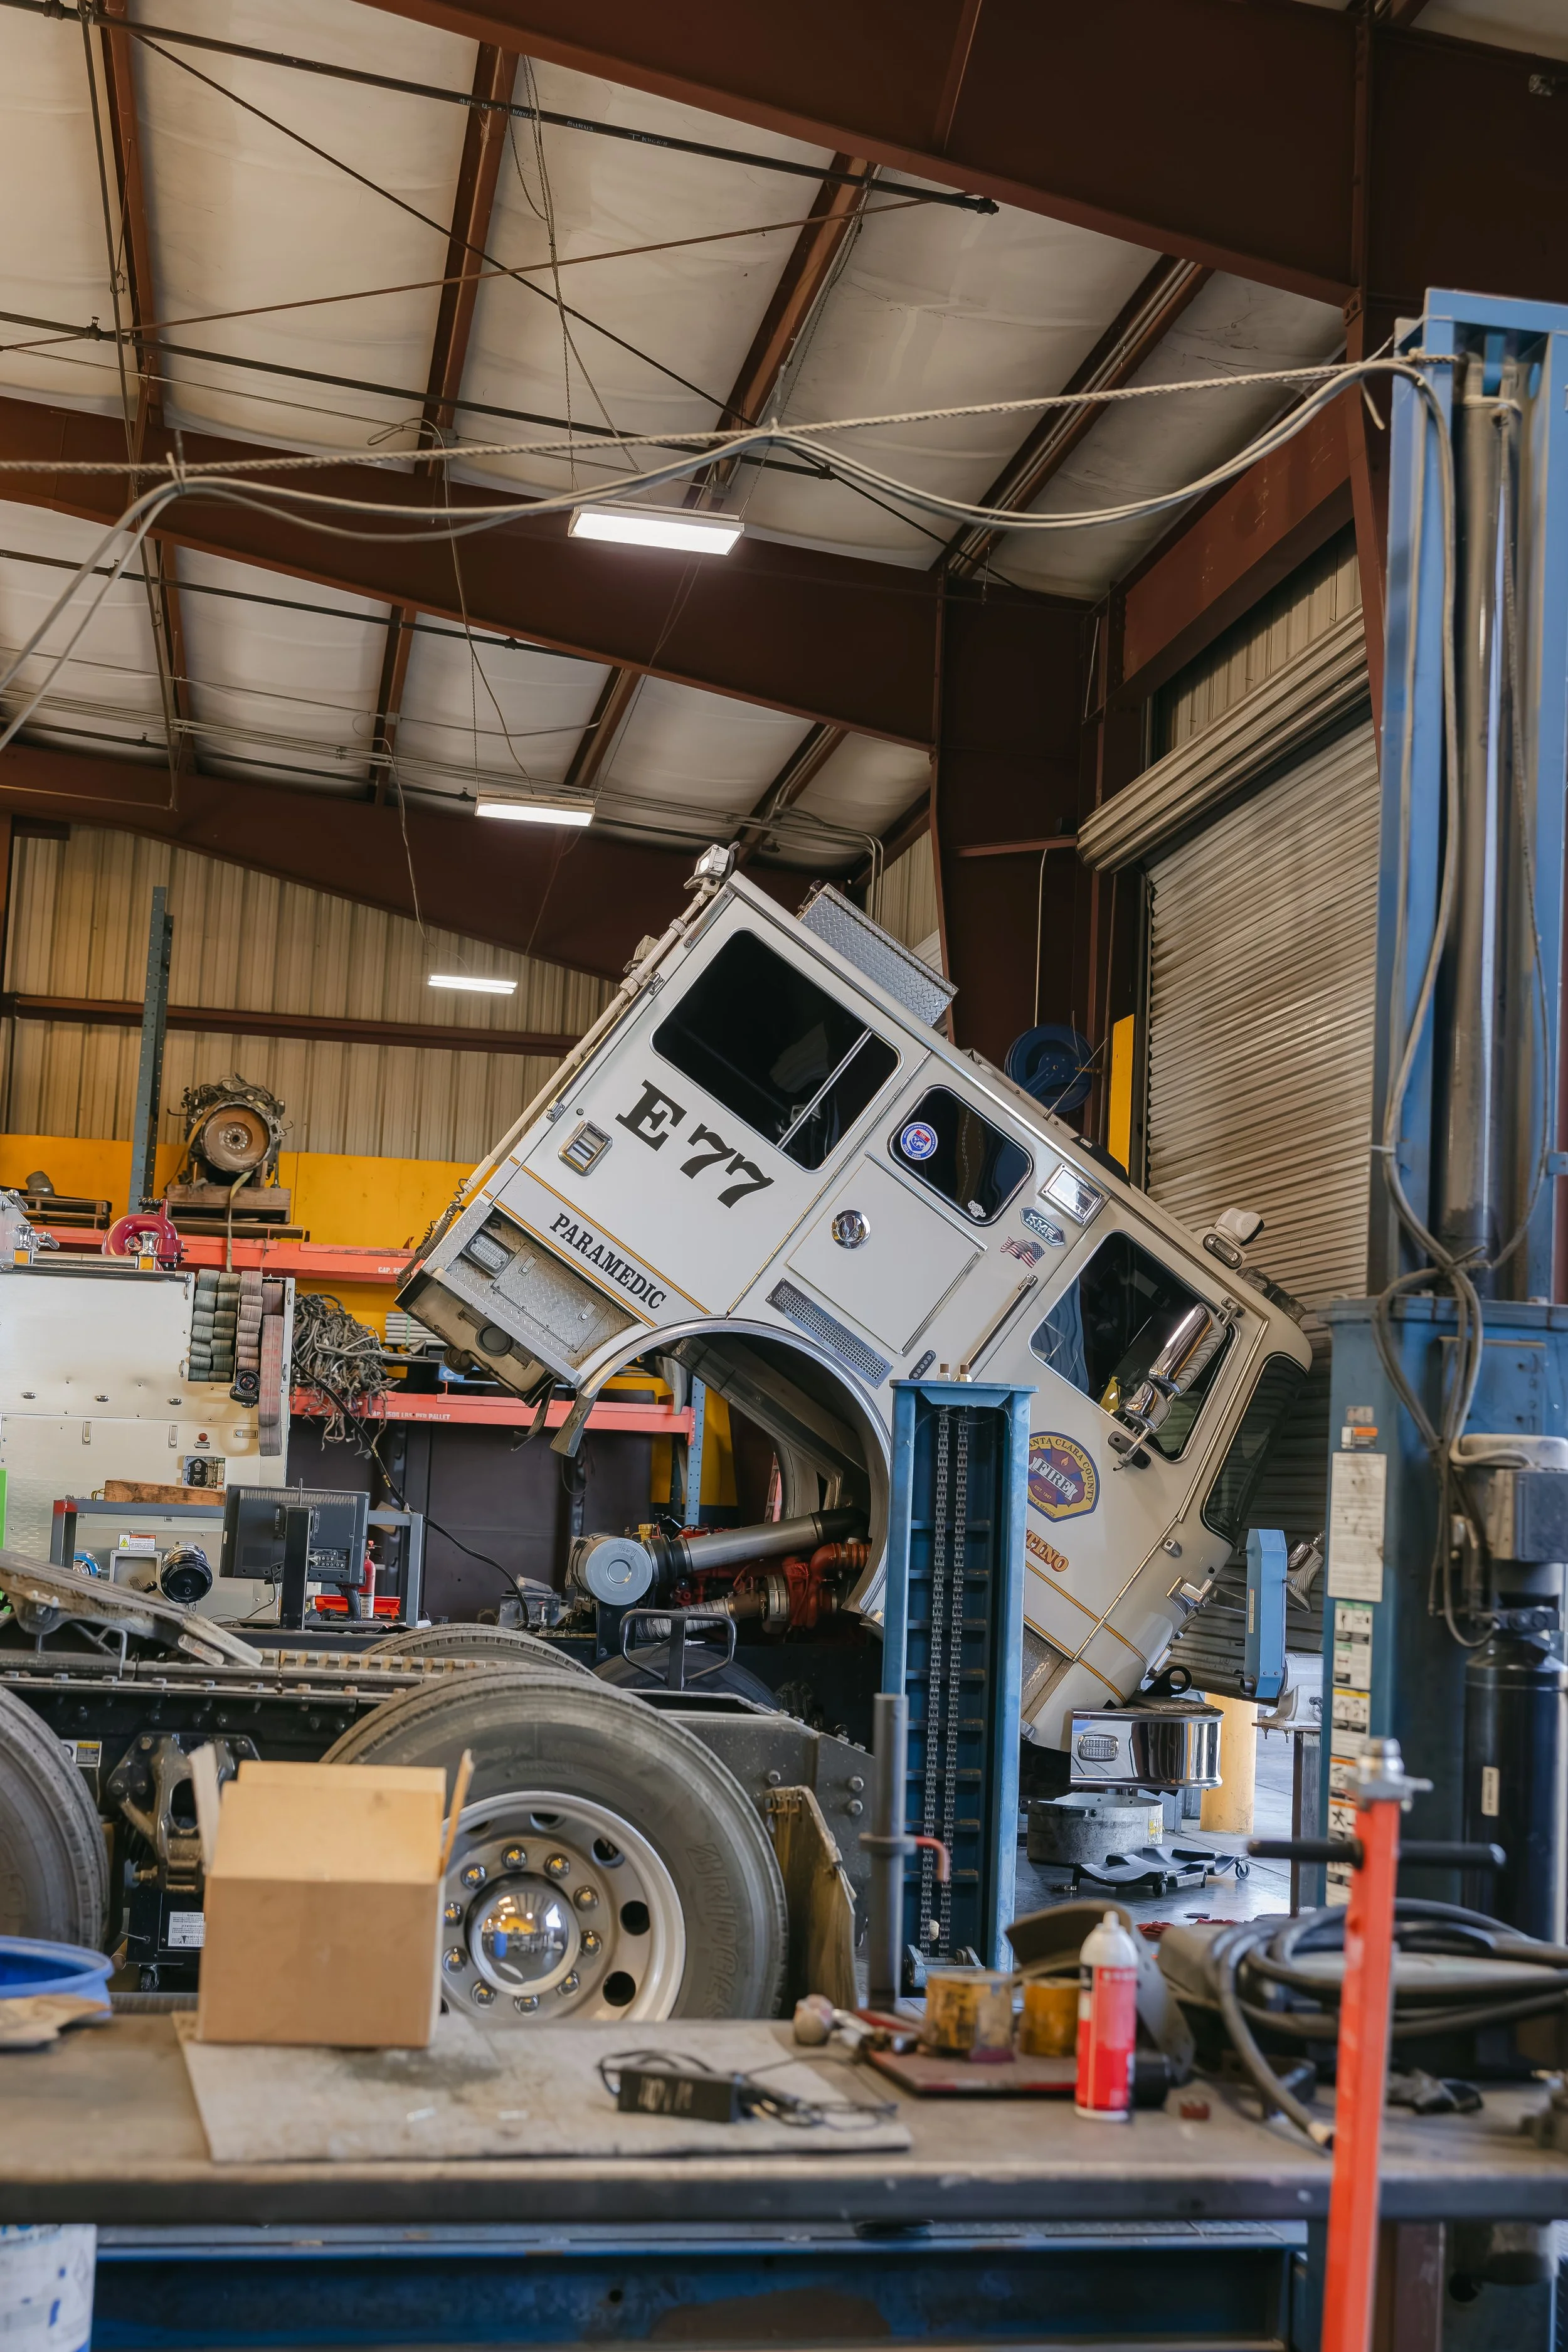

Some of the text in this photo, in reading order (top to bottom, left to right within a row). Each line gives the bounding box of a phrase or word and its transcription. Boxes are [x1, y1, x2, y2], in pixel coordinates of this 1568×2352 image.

[615, 1079, 775, 1209] E 77
[1027, 1212, 1056, 1238] KME
[549, 1212, 667, 1310] PARAMEDIC
[1029, 1437, 1094, 1503] ANTA CLARA COUNTY
[1036, 1460, 1072, 1493] FIRE
[1039, 1503, 1056, 1518] SERVICE
[1026, 1529, 1069, 1572] TINO
